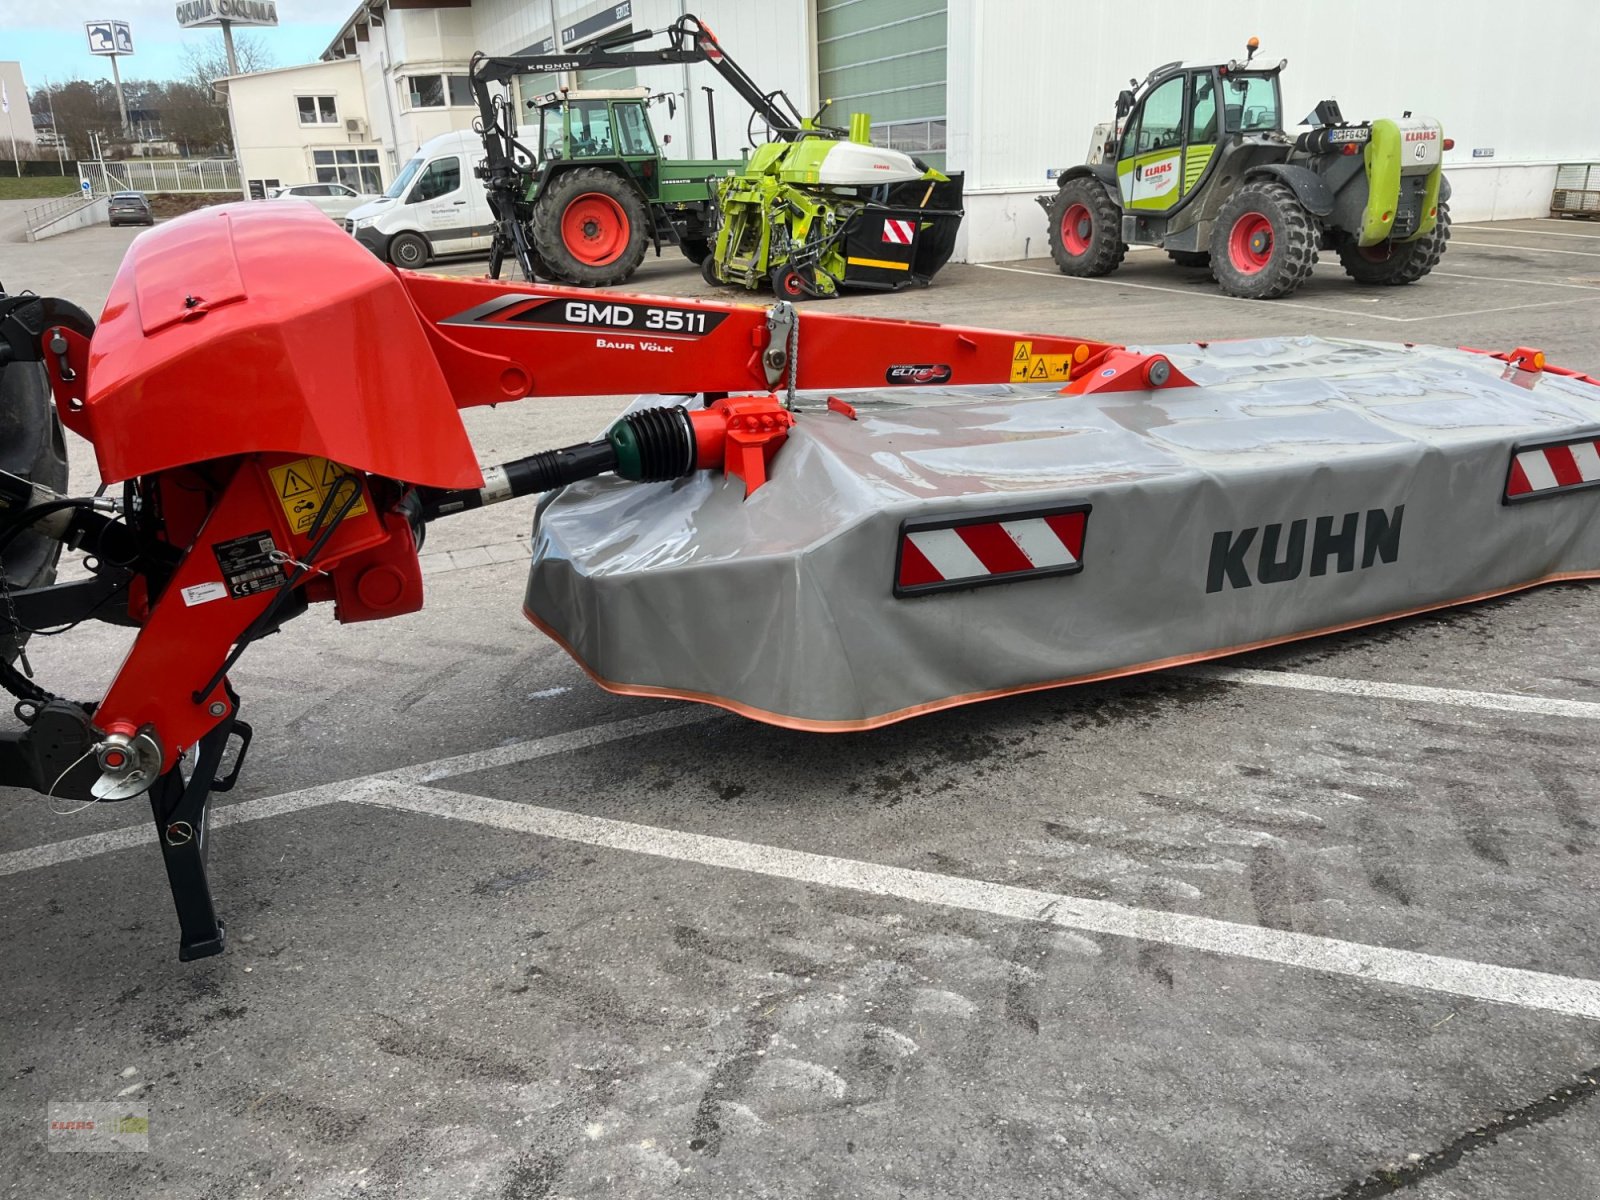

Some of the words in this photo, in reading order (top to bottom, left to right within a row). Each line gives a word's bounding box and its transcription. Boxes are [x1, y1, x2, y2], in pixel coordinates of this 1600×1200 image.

[176, 0, 216, 24] OKUMA
[219, 0, 278, 23] OKUMA
[527, 61, 580, 71] KRONOS
[1405, 131, 1437, 142] CLAAS
[1415, 145, 1426, 159] 40
[1144, 162, 1172, 177] CLAAS
[565, 301, 634, 327] GMD
[645, 308, 706, 333] 3511
[891, 368, 929, 376] ELITE
[1206, 504, 1405, 594] KUHN
